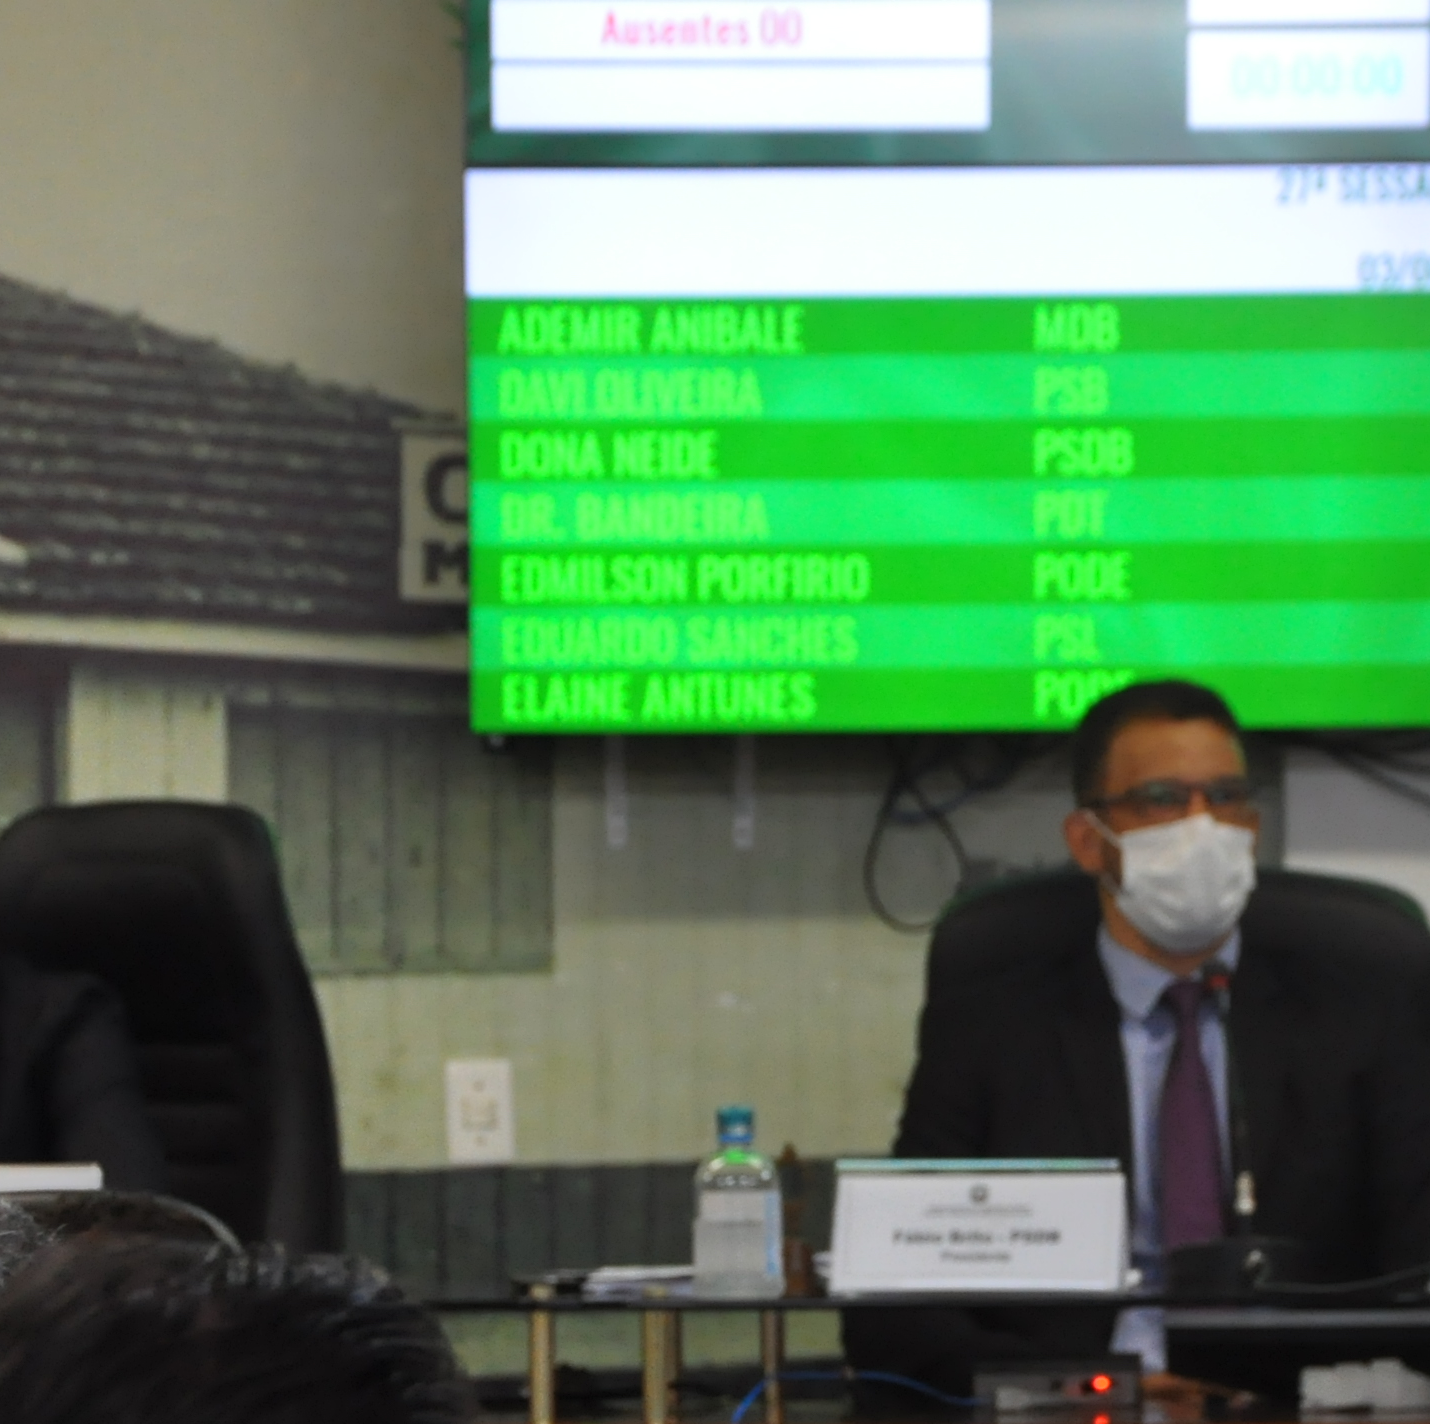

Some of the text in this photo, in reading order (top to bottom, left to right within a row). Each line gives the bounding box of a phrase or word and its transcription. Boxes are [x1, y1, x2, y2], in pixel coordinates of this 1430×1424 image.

[601, 10, 749, 46] Ausentes
[497, 304, 805, 355] ADEMIR ANIBALE
[1034, 304, 1121, 352] MDB
[498, 368, 763, 418] DAVI OLIVEIRA
[1034, 365, 1109, 416] PSB
[499, 430, 720, 479] DONA NEIDE
[1034, 427, 1135, 476] PSDB
[500, 491, 770, 541] DR. BANDEIRA
[500, 553, 871, 604] EDMILSON PORFIRIO
[1034, 551, 1132, 600] PODE
[502, 615, 859, 666] EDUARDO SANCHES
[502, 673, 817, 722] ELAINE ANTUNES
